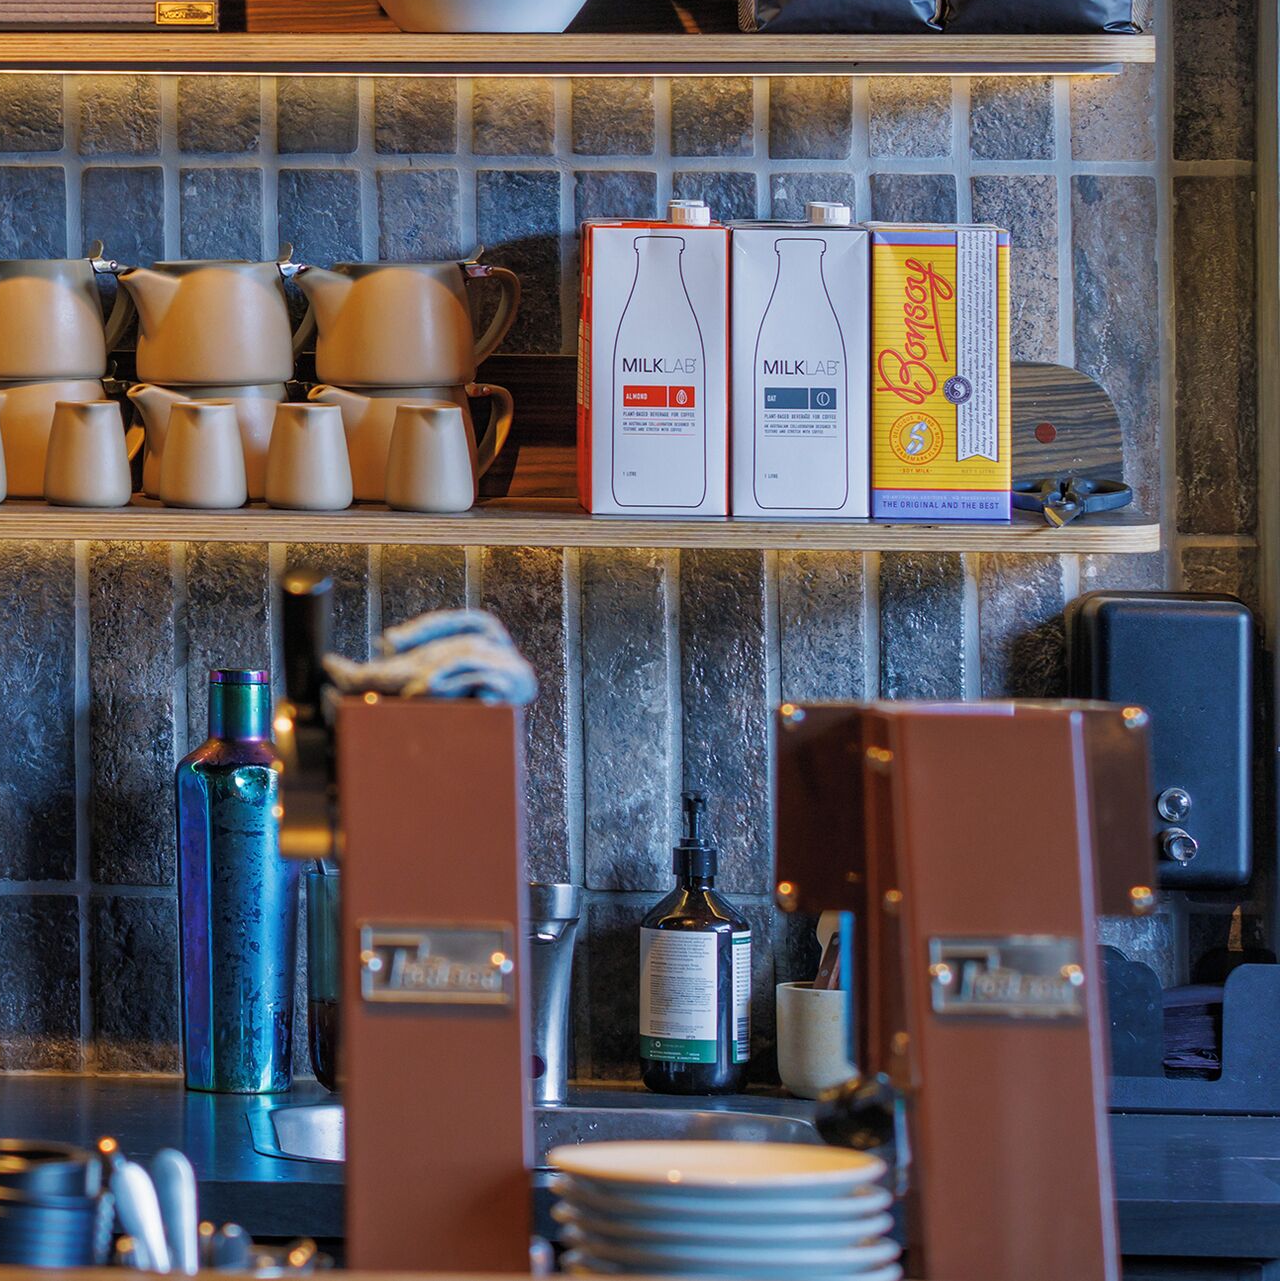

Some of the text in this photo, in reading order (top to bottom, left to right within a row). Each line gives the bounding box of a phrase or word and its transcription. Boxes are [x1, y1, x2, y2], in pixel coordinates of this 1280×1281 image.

[876, 258, 954, 405] Bonsoy
[622, 357, 695, 374] MILKLAB
[763, 360, 838, 376] MILKLAB
[900, 501, 939, 509] ORIGINAL
[941, 501, 959, 509] AND
